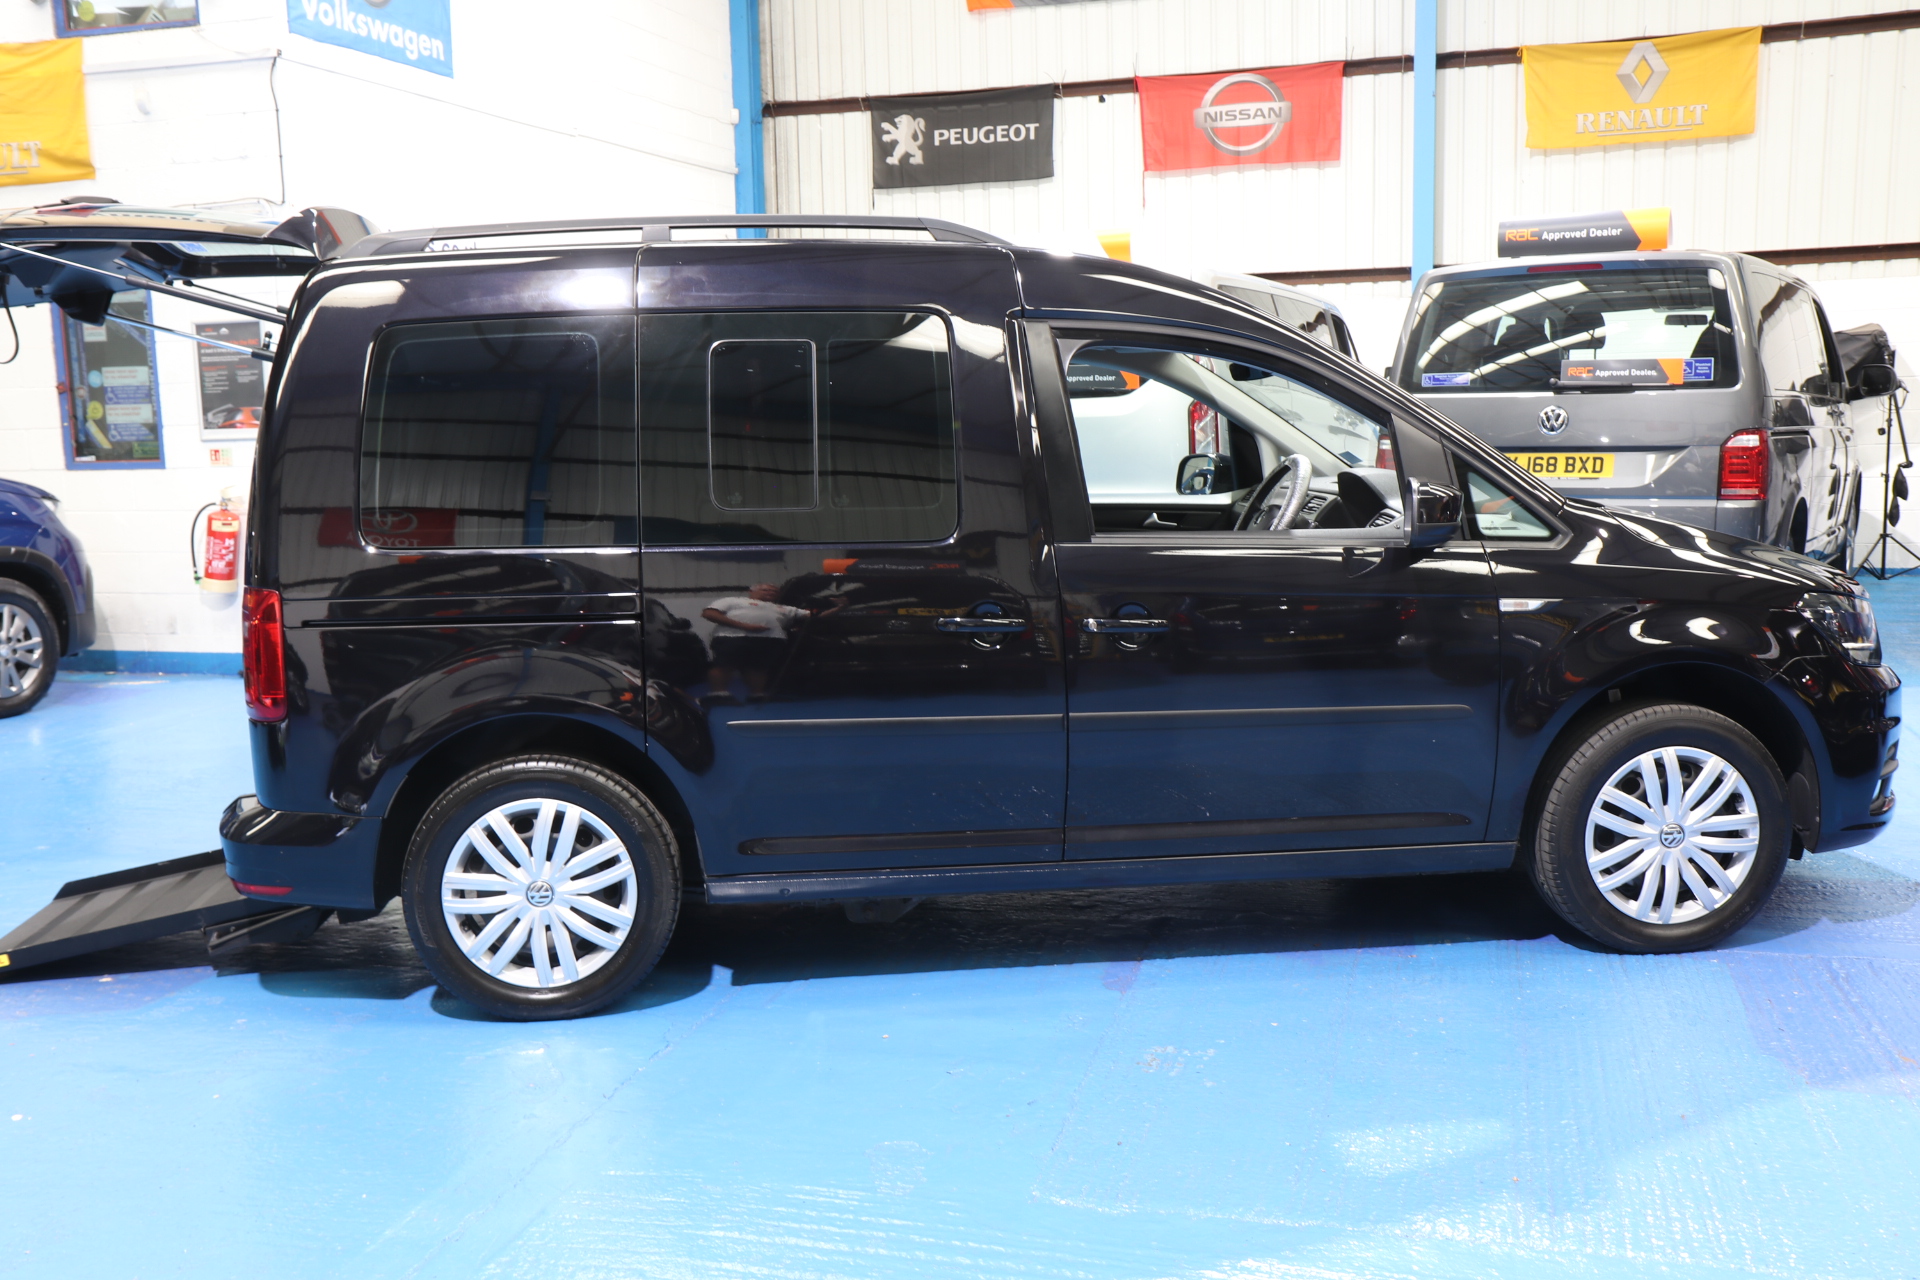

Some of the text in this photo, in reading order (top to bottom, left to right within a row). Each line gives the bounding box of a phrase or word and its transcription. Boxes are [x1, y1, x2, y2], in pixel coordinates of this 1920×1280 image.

[301, 0, 445, 61] Volkswagen
[1203, 106, 1283, 124] NISSAN
[1575, 104, 1709, 134] RENAULT
[933, 123, 1040, 146] PEUGEOT
[1542, 229, 1587, 241] Approved
[1589, 227, 1623, 237] Dealer
[1595, 368, 1629, 378] Approved
[1630, 368, 1657, 376] Dealer
[1563, 456, 1605, 474] BXD
